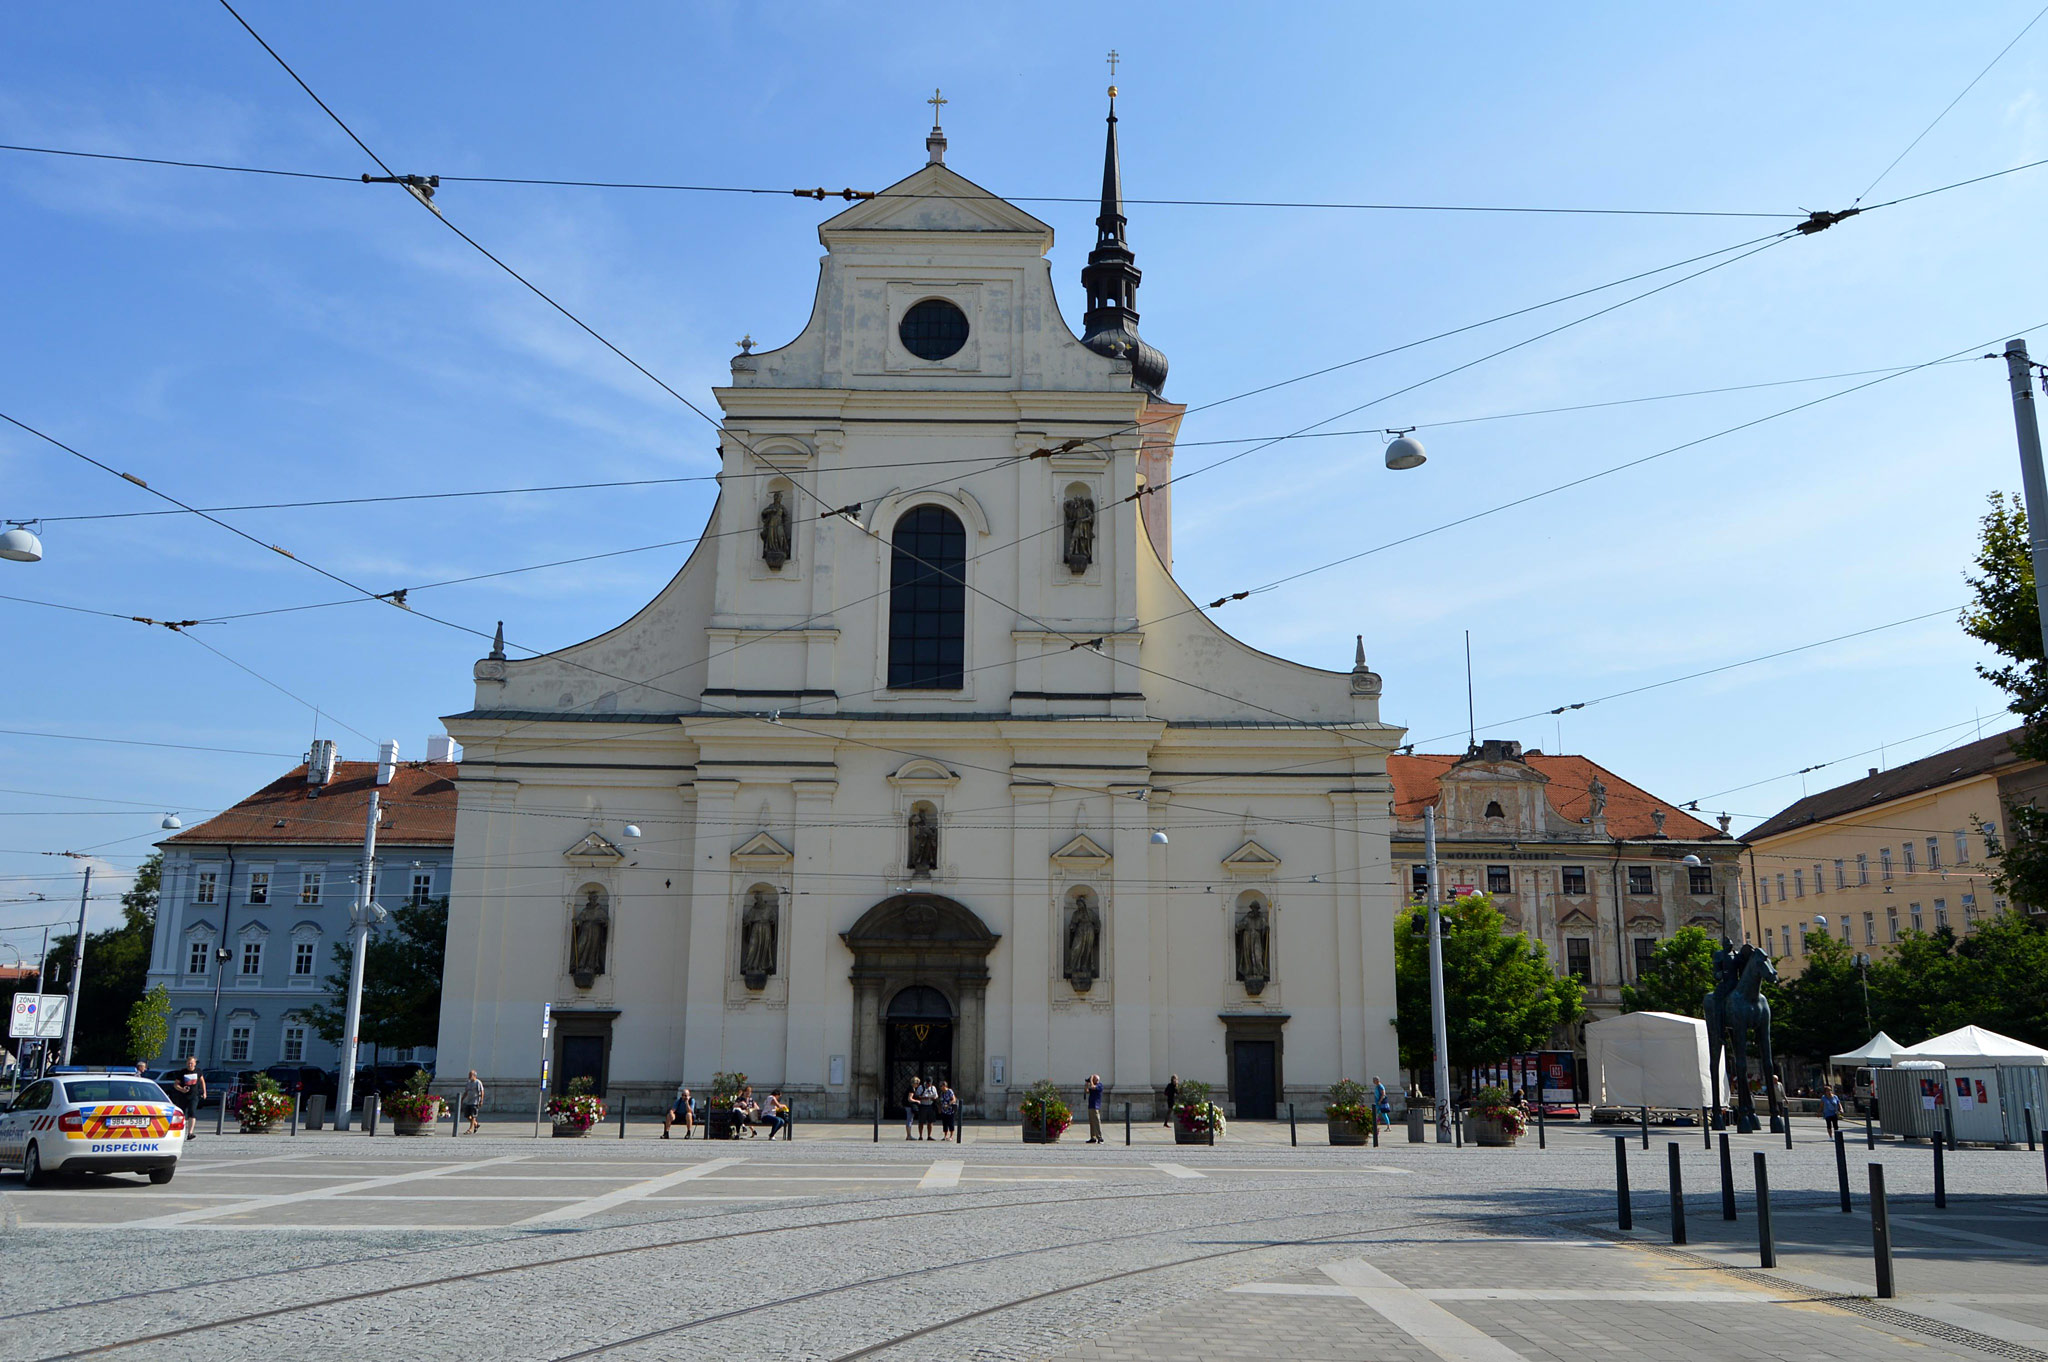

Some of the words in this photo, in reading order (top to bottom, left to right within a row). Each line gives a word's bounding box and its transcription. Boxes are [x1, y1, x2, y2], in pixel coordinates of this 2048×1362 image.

[1447, 852, 1503, 860] MORAVSKÁ
[1509, 852, 1550, 860] GALERIE
[92, 1142, 159, 1153] DISPEČINK
